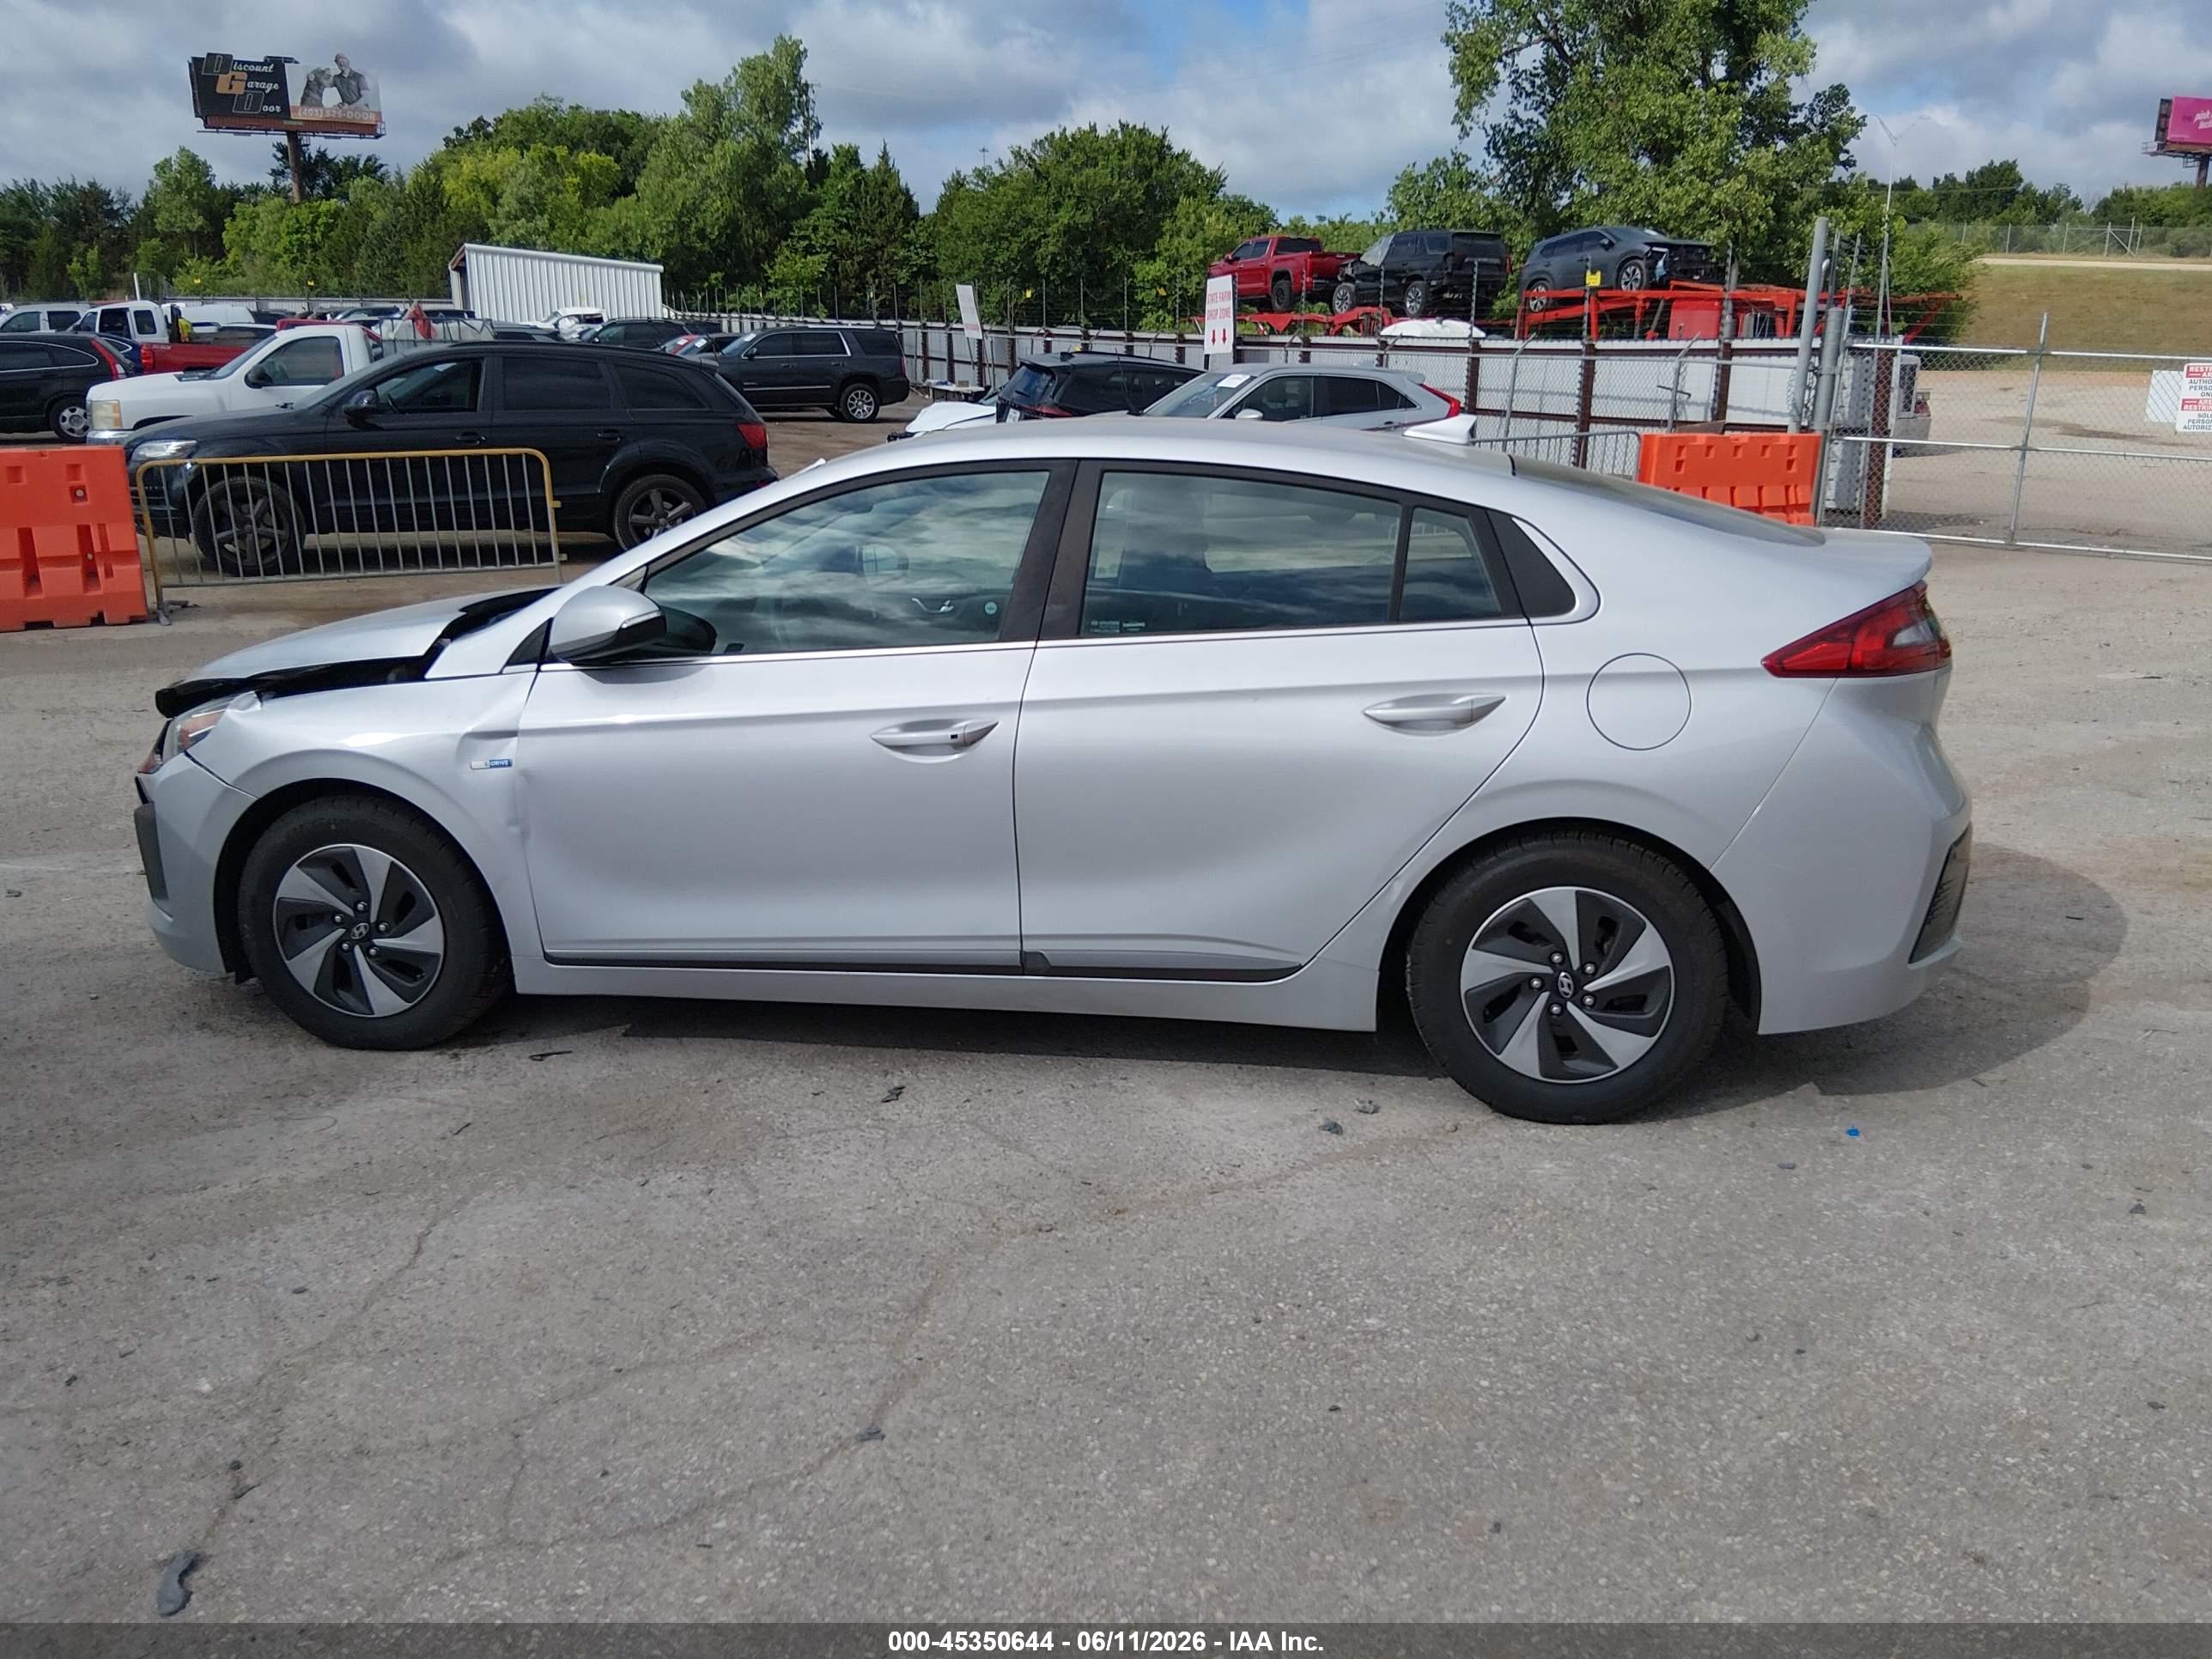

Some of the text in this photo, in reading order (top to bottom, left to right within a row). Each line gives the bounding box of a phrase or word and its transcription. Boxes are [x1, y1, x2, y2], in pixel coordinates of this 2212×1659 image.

[202, 53, 274, 75] Discount
[216, 71, 280, 94] Garage
[232, 90, 282, 114] Door
